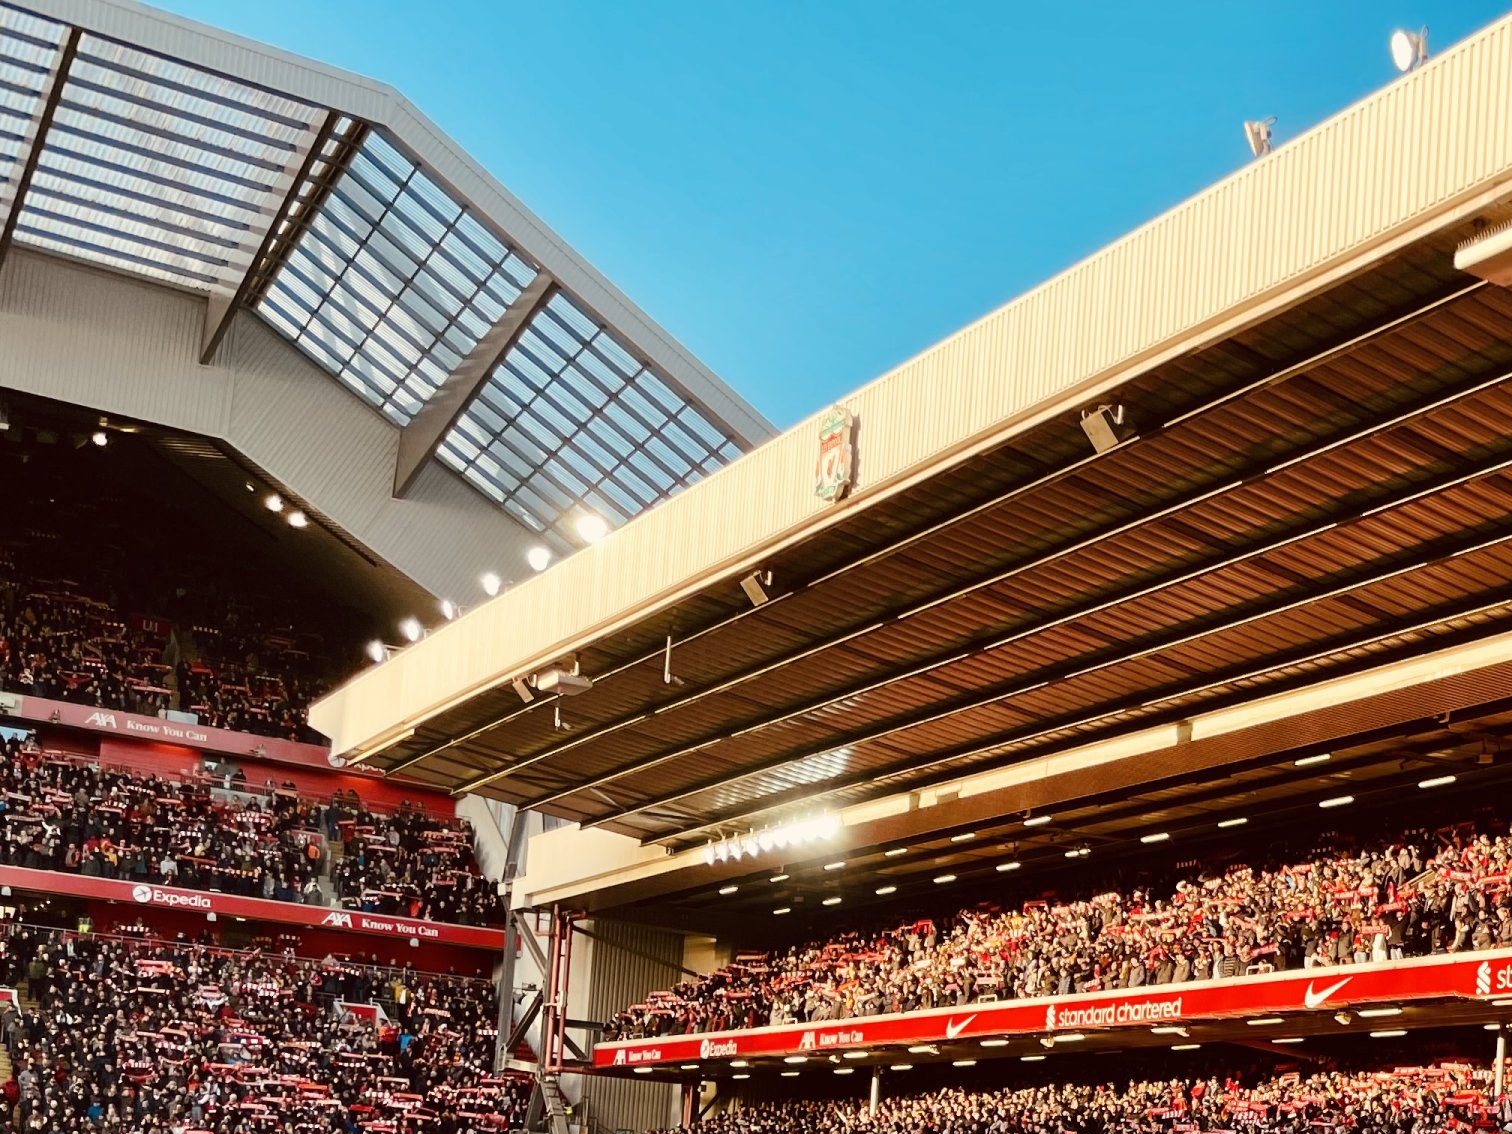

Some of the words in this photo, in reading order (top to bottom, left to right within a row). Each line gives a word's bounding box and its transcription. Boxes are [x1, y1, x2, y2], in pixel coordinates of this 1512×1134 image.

[85, 712, 117, 728] AXA
[126, 720, 160, 734] Know
[162, 725, 184, 738] You
[185, 730, 208, 742] Can
[153, 889, 212, 907] Expedia
[321, 911, 353, 929] AXA
[361, 918, 394, 931] Know
[396, 923, 417, 934] You
[418, 926, 439, 937] Can
[1058, 1003, 1116, 1027] standard
[1117, 996, 1183, 1020] chartered
[709, 1040, 738, 1057] Expedia
